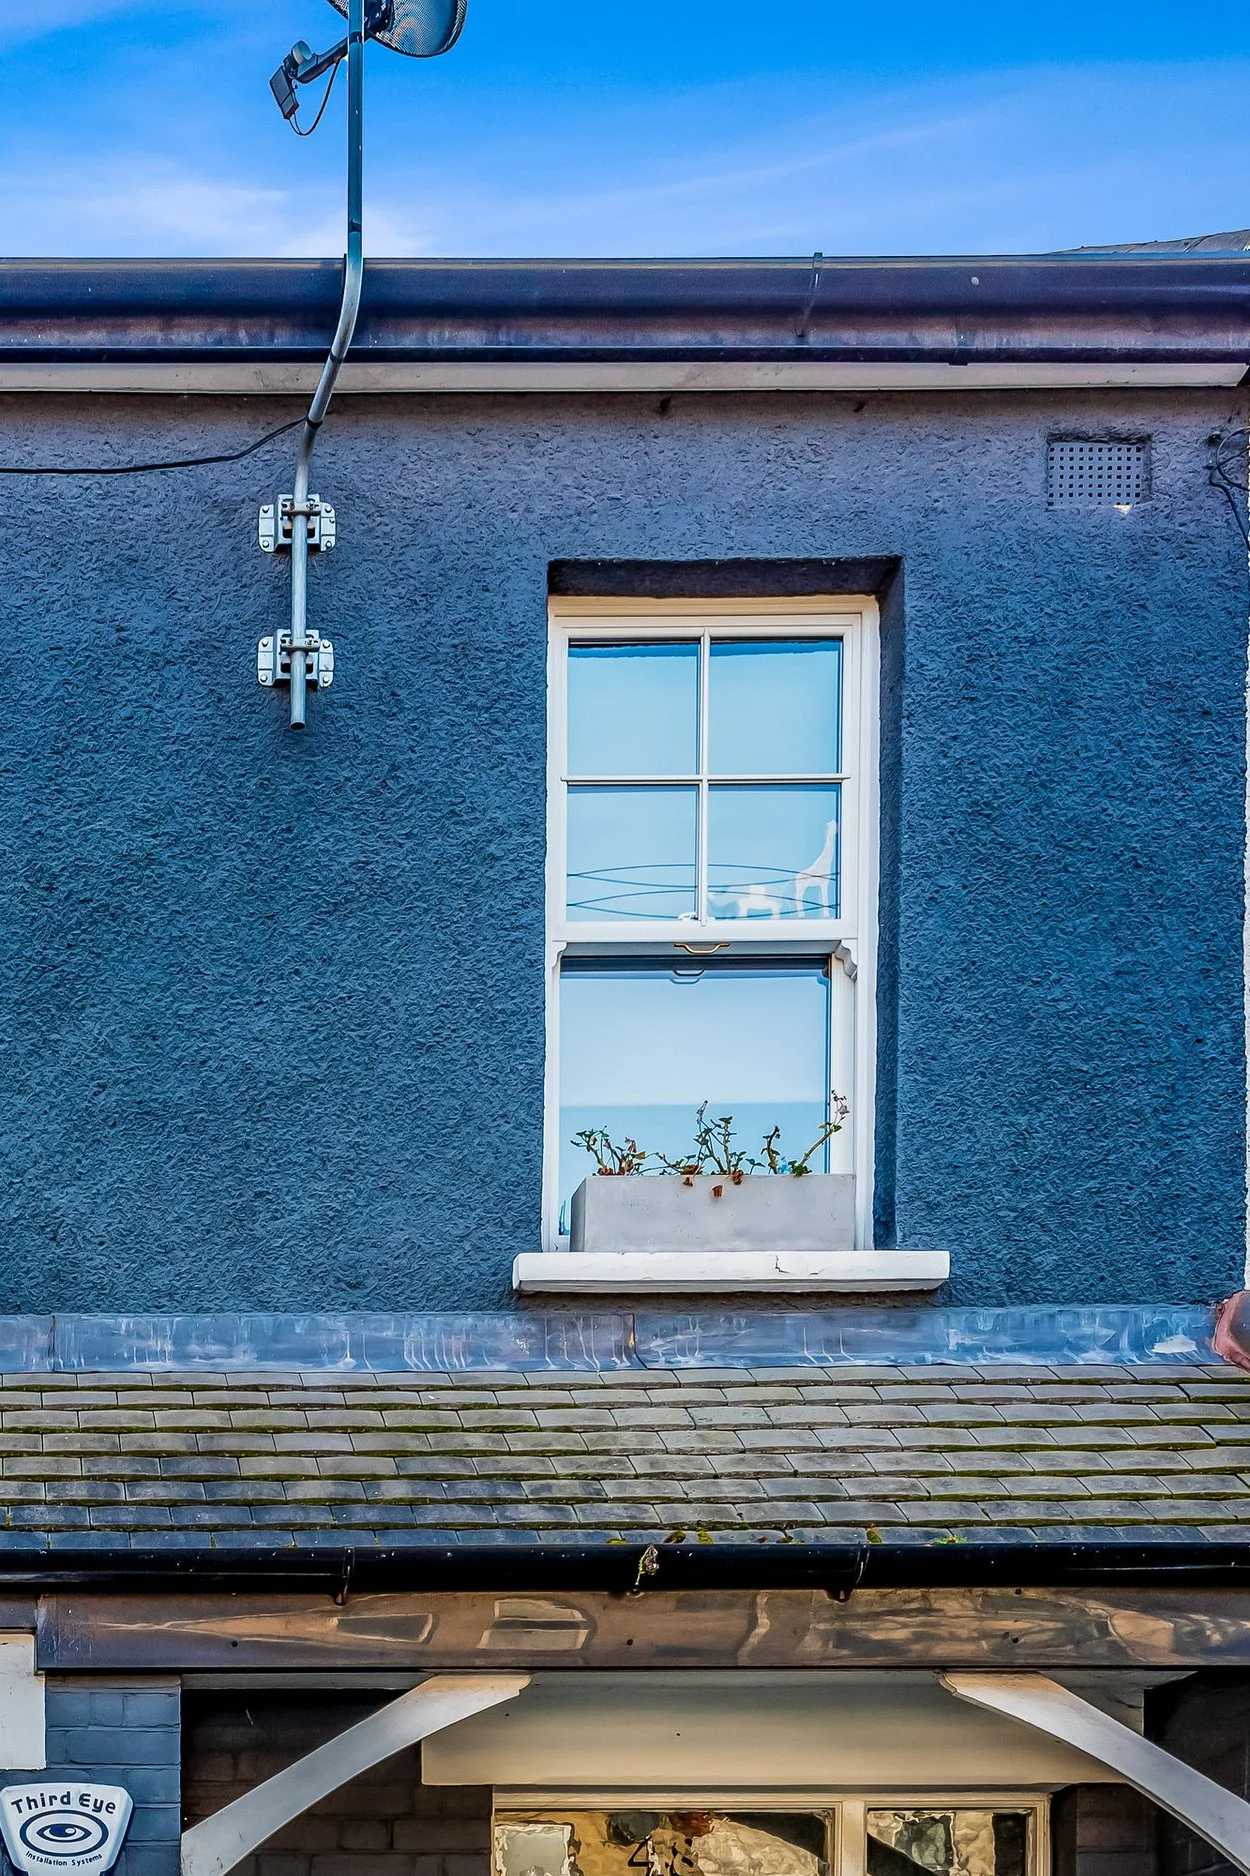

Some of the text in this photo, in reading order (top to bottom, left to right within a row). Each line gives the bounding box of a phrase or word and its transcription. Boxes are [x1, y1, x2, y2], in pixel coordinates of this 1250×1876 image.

[11, 1791, 116, 1814] Third Eye
[25, 1851, 103, 1867] Installation Systems
